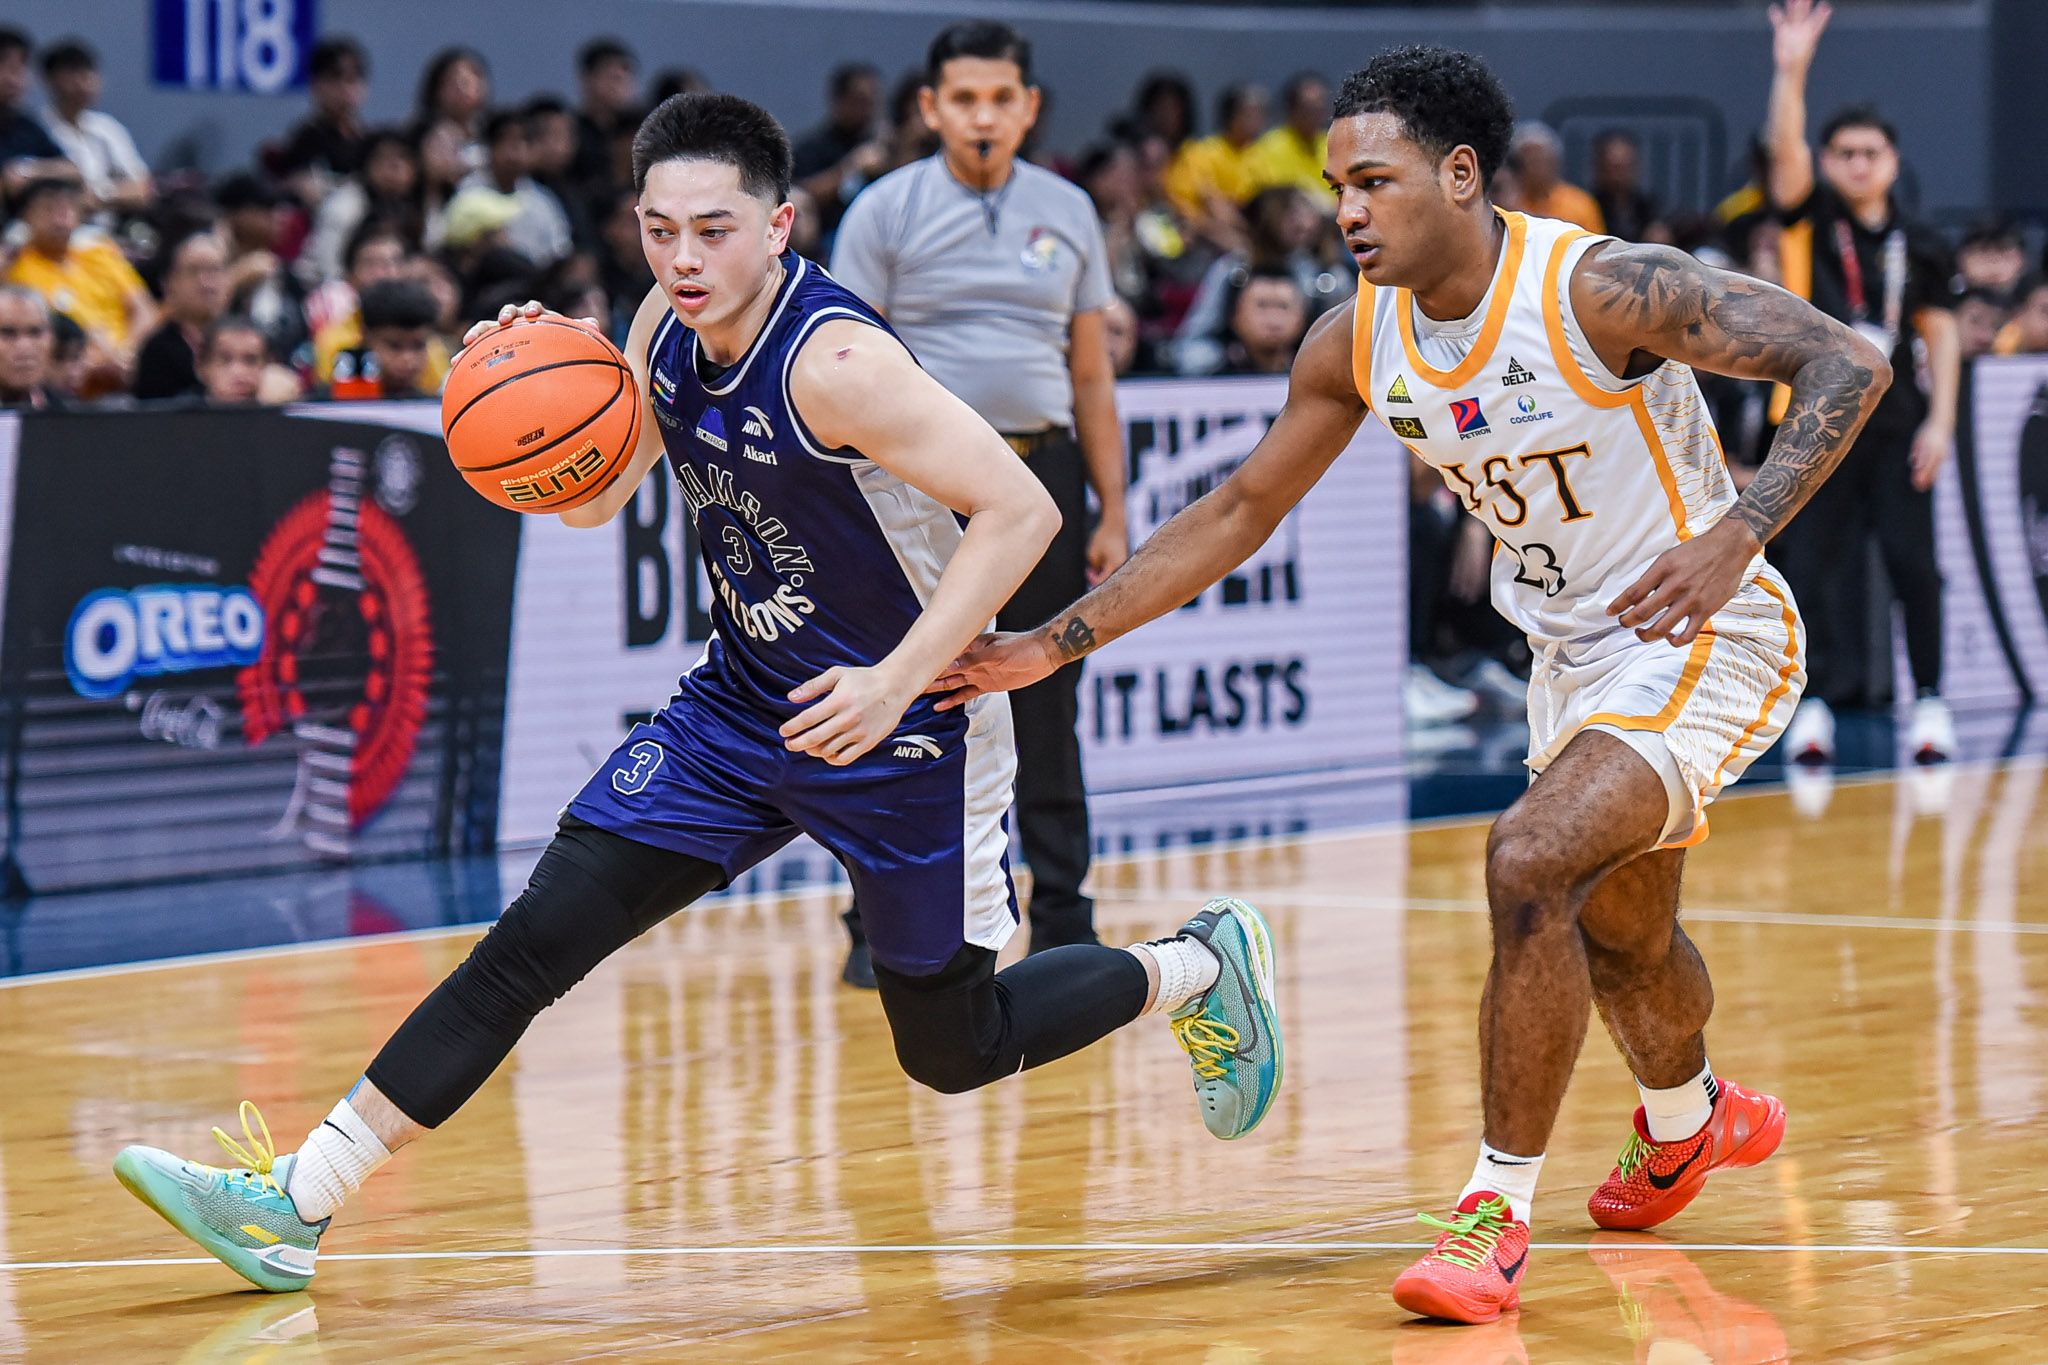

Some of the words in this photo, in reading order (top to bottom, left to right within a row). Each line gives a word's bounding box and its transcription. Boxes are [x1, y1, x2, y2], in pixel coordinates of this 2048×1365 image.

[185, 0, 295, 91] 118
[655, 367, 677, 393] DAVIES
[1501, 371, 1536, 387] DELTA
[741, 420, 762, 437] ANTA
[1459, 427, 1492, 441] PETRON
[1510, 411, 1554, 425] COCOLIFE
[500, 439, 593, 486] CHAMPIONSHIP
[742, 443, 778, 466] Akari
[504, 445, 606, 504] ELITE
[721, 525, 753, 576] 3
[73, 590, 264, 682] OREO
[1094, 673, 1138, 740] IT
[1157, 658, 1307, 734] LASTS
[612, 741, 665, 796] 3
[892, 745, 923, 759] ANTA
